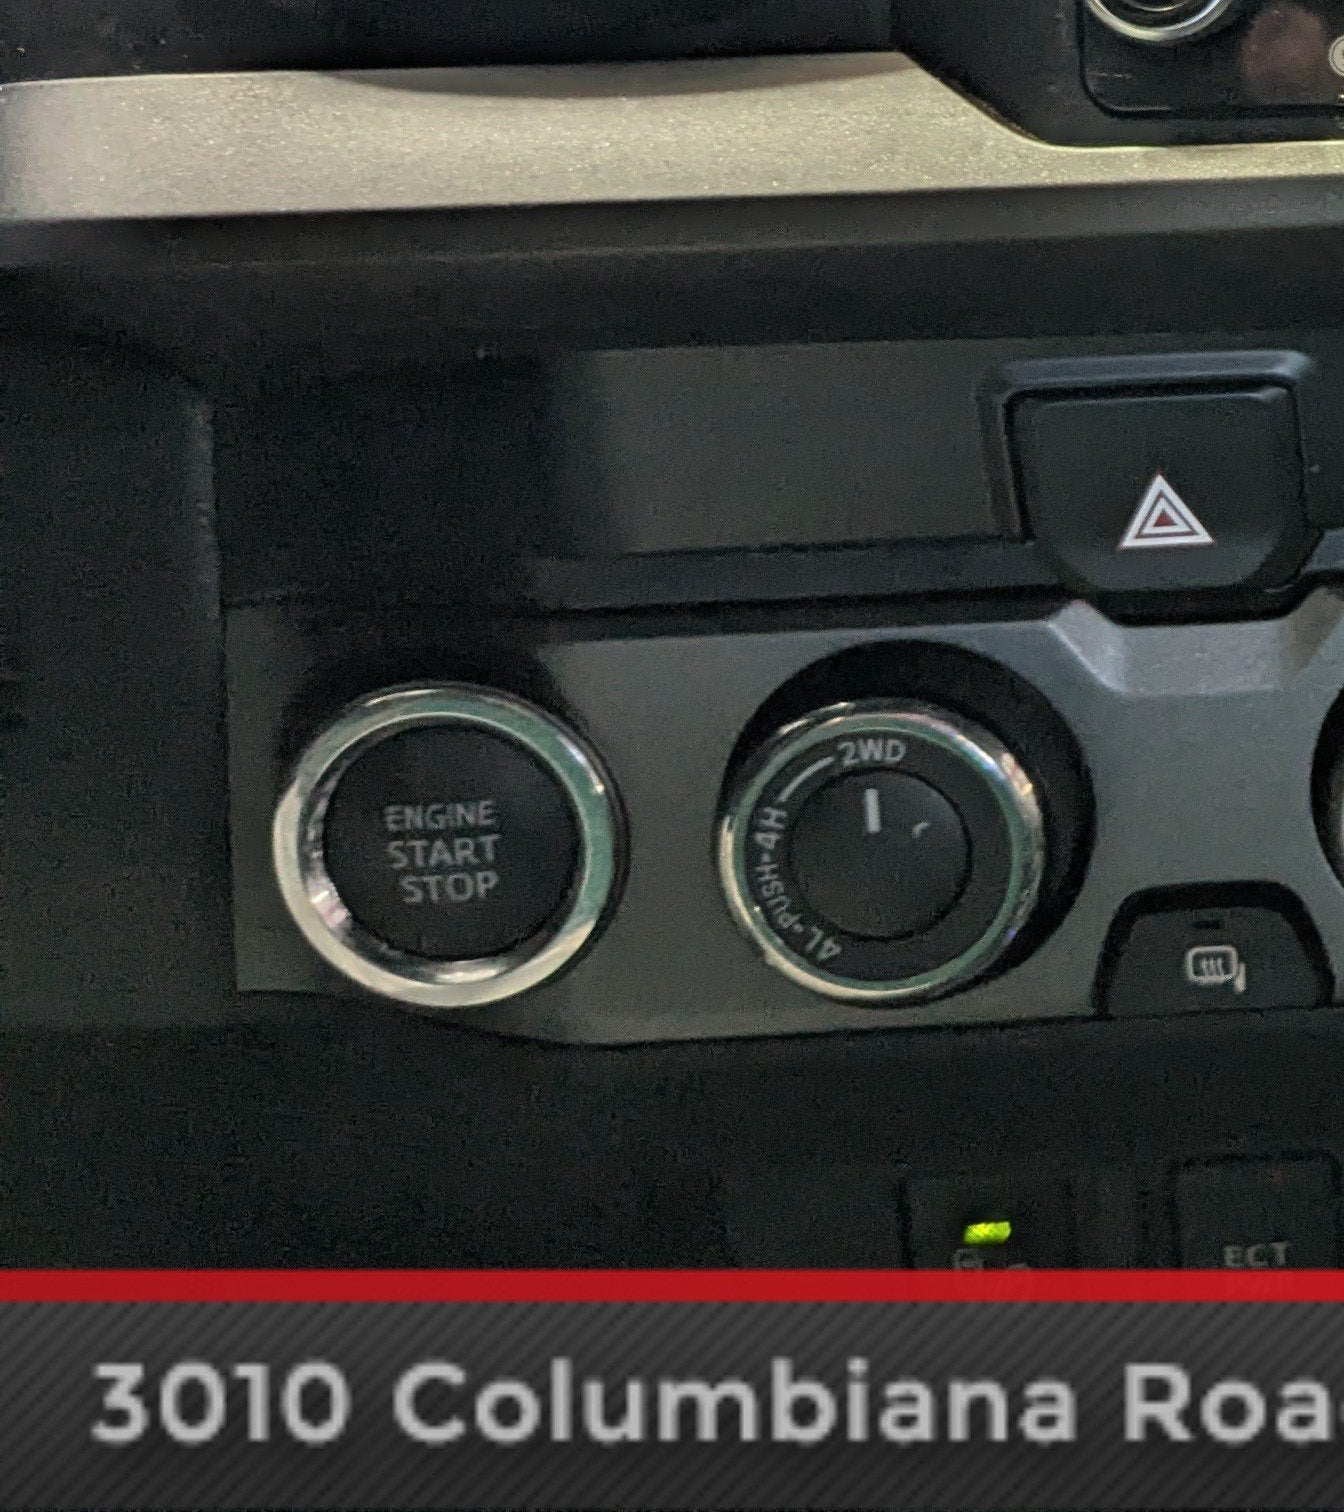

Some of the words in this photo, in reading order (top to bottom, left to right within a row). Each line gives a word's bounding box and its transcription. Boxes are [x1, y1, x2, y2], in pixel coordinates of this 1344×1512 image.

[838, 738, 907, 766] 2WD
[384, 800, 498, 832] ENGINE
[387, 834, 500, 868] START
[400, 871, 500, 903] STOP
[1222, 1242, 1291, 1268] ECT
